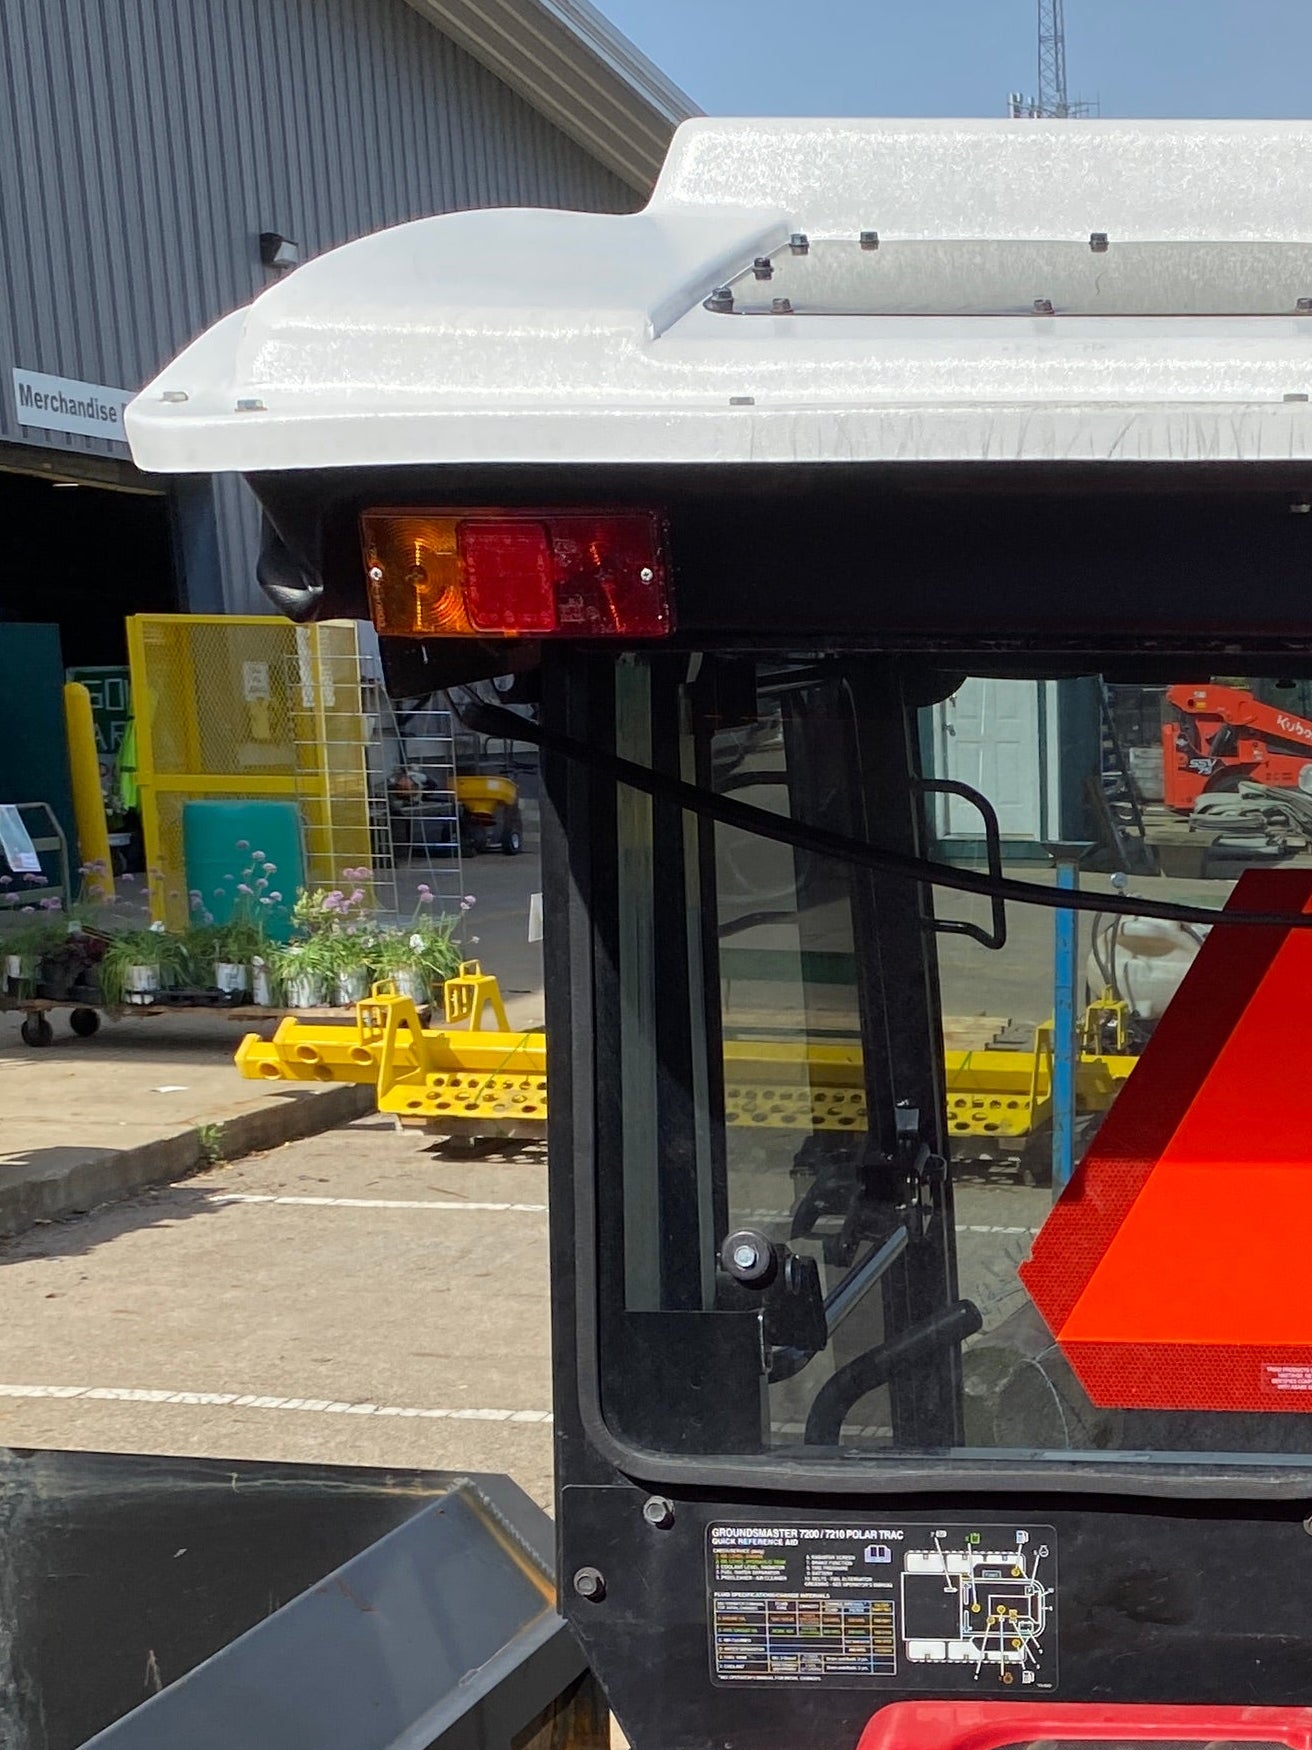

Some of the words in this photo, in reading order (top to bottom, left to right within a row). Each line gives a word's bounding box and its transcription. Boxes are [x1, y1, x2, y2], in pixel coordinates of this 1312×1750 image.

[19, 382, 118, 423] Merchandise
[711, 1527, 798, 1538] GROUNDSMASTER
[799, 1528, 820, 1539] 7200
[824, 1528, 845, 1539] 7210
[846, 1529, 877, 1540] POLAR
[878, 1529, 904, 1540] TRAC
[711, 1537, 737, 1546] QUICK
[737, 1537, 784, 1546] REFERENCE
[785, 1538, 799, 1546] AID
